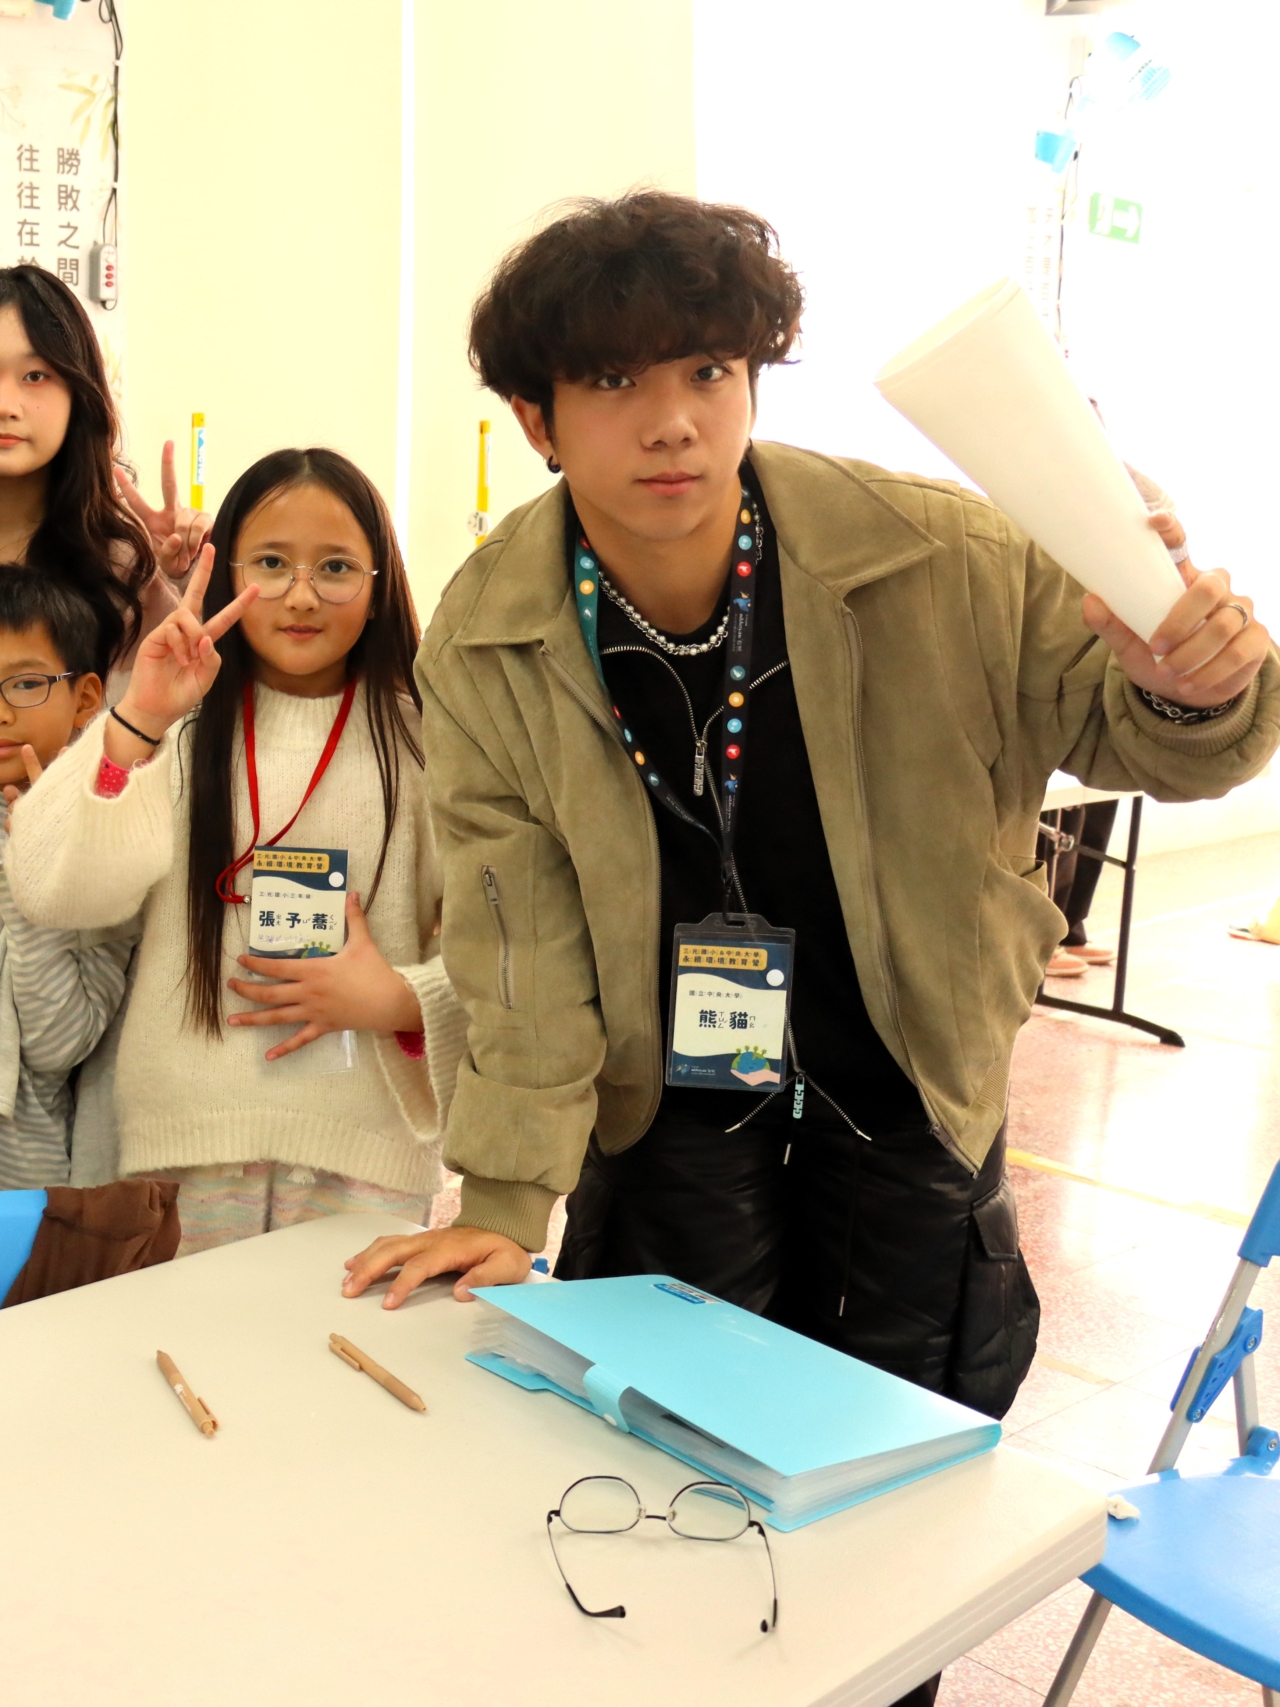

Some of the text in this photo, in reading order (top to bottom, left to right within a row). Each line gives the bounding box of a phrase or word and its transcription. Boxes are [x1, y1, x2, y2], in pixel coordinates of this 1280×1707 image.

[16, 143, 41, 267] 往往在
[56, 147, 81, 287] 勝敗之間
[698, 1009, 749, 1030] 熊貓
